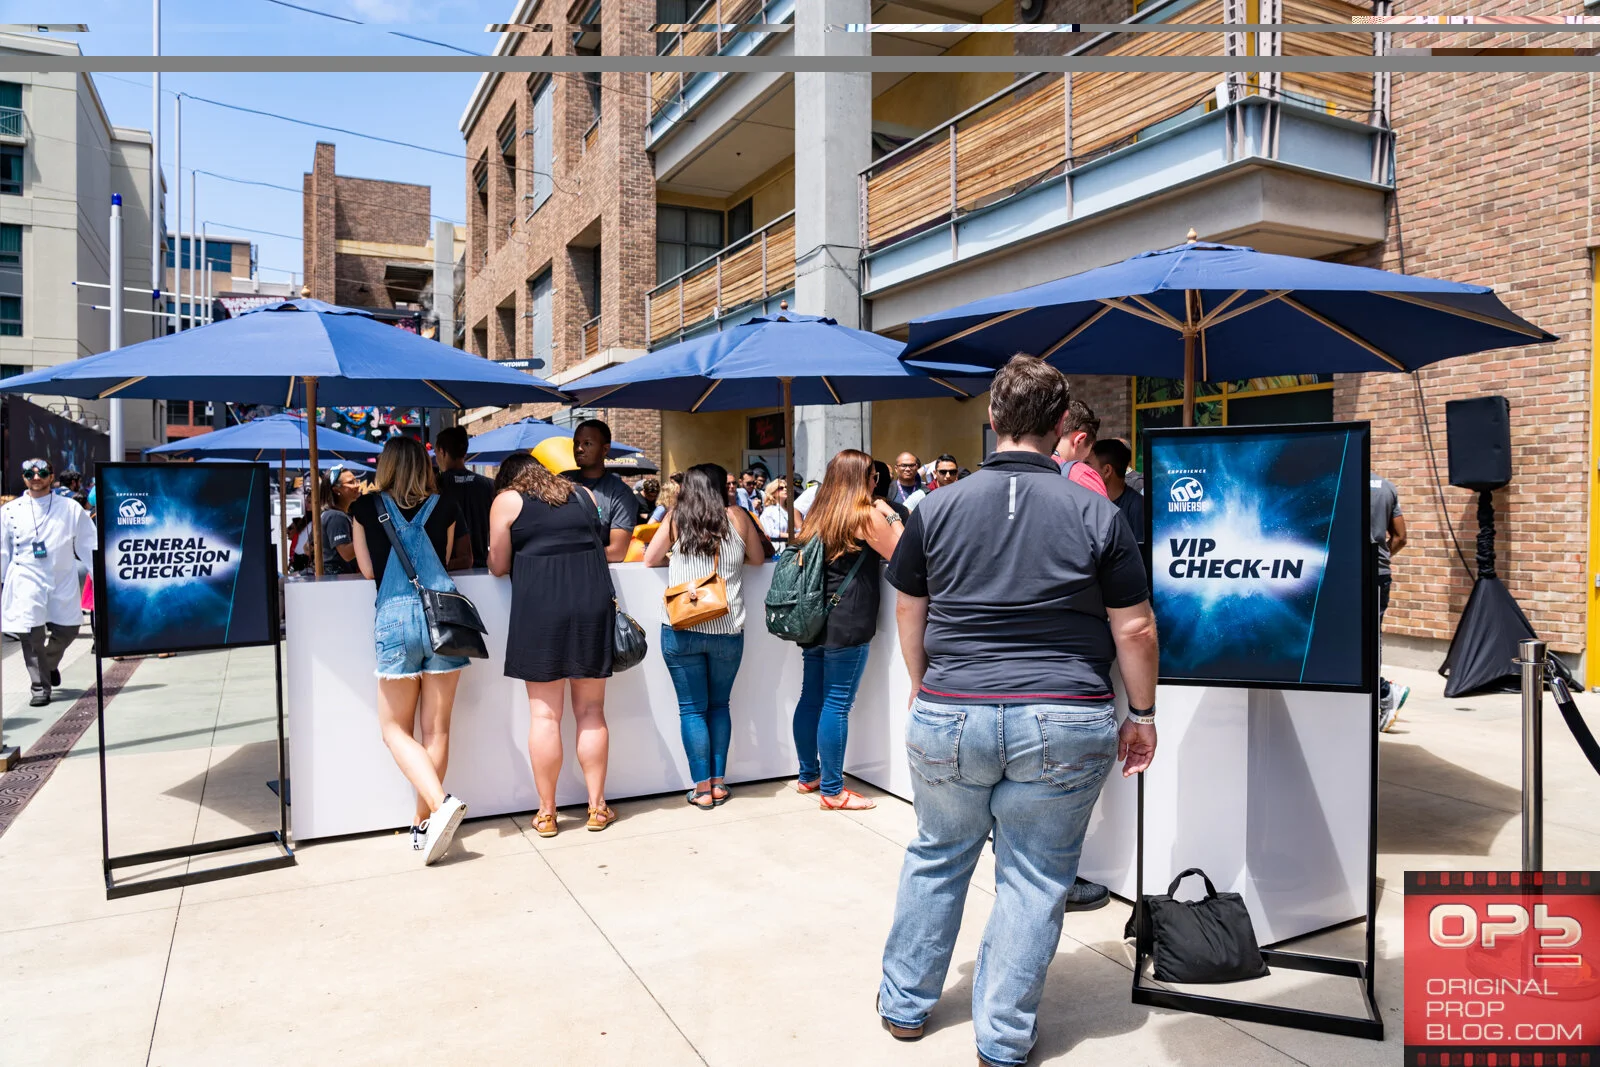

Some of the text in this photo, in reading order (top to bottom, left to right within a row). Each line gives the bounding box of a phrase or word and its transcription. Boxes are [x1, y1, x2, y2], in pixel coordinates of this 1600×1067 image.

[1170, 477, 1203, 502] DC
[119, 498, 147, 518] DC
[118, 537, 207, 552] GENERAL
[1169, 538, 1217, 558] VIP
[118, 550, 231, 567] ADMISSION
[1168, 558, 1304, 579] CHECK-IN
[118, 564, 213, 581] CHECK-IN
